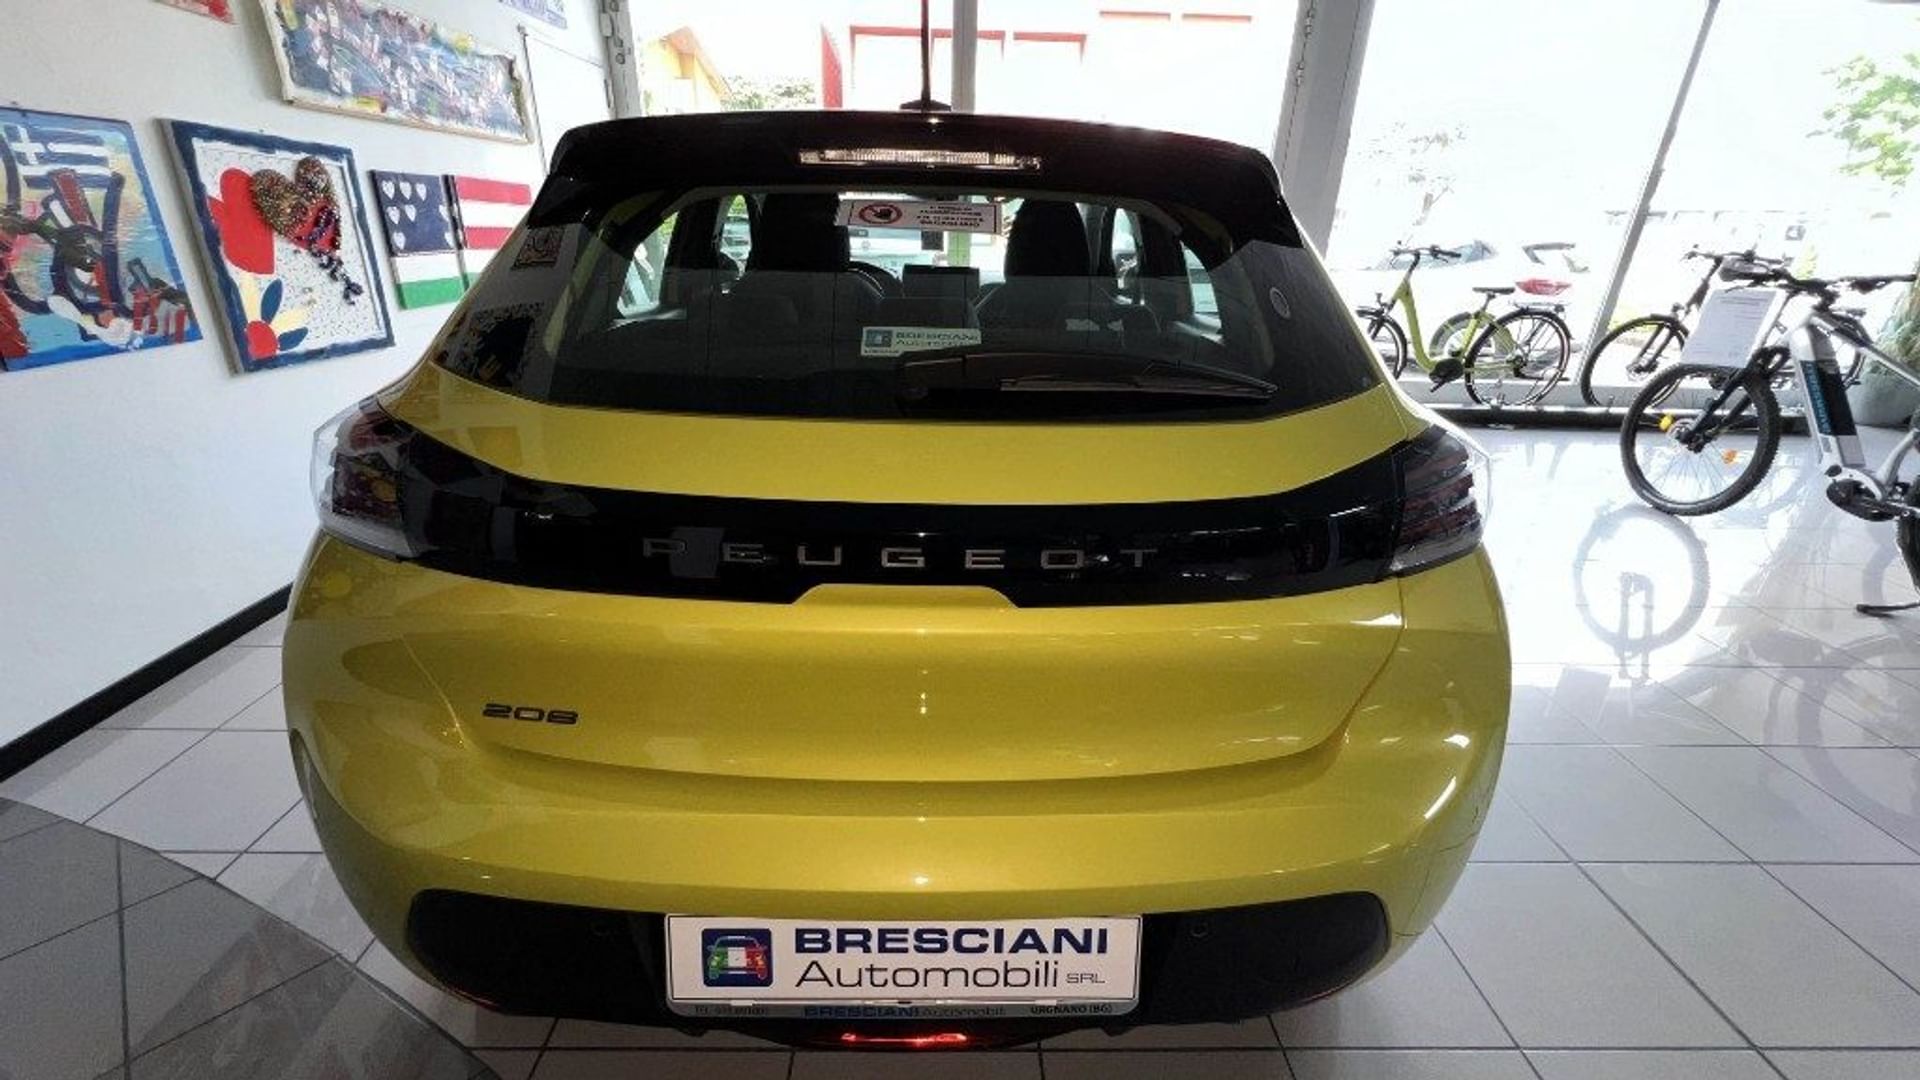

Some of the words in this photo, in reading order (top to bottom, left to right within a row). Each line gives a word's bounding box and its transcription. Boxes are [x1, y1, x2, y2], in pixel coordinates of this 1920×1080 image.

[643, 537, 1159, 569] PEUGEOT
[482, 703, 579, 725] 208
[794, 927, 1108, 954] BRESCIANI
[795, 960, 1059, 988] Automobili
[1066, 972, 1106, 984] SRL
[804, 1005, 919, 1018] BRESCIANI
